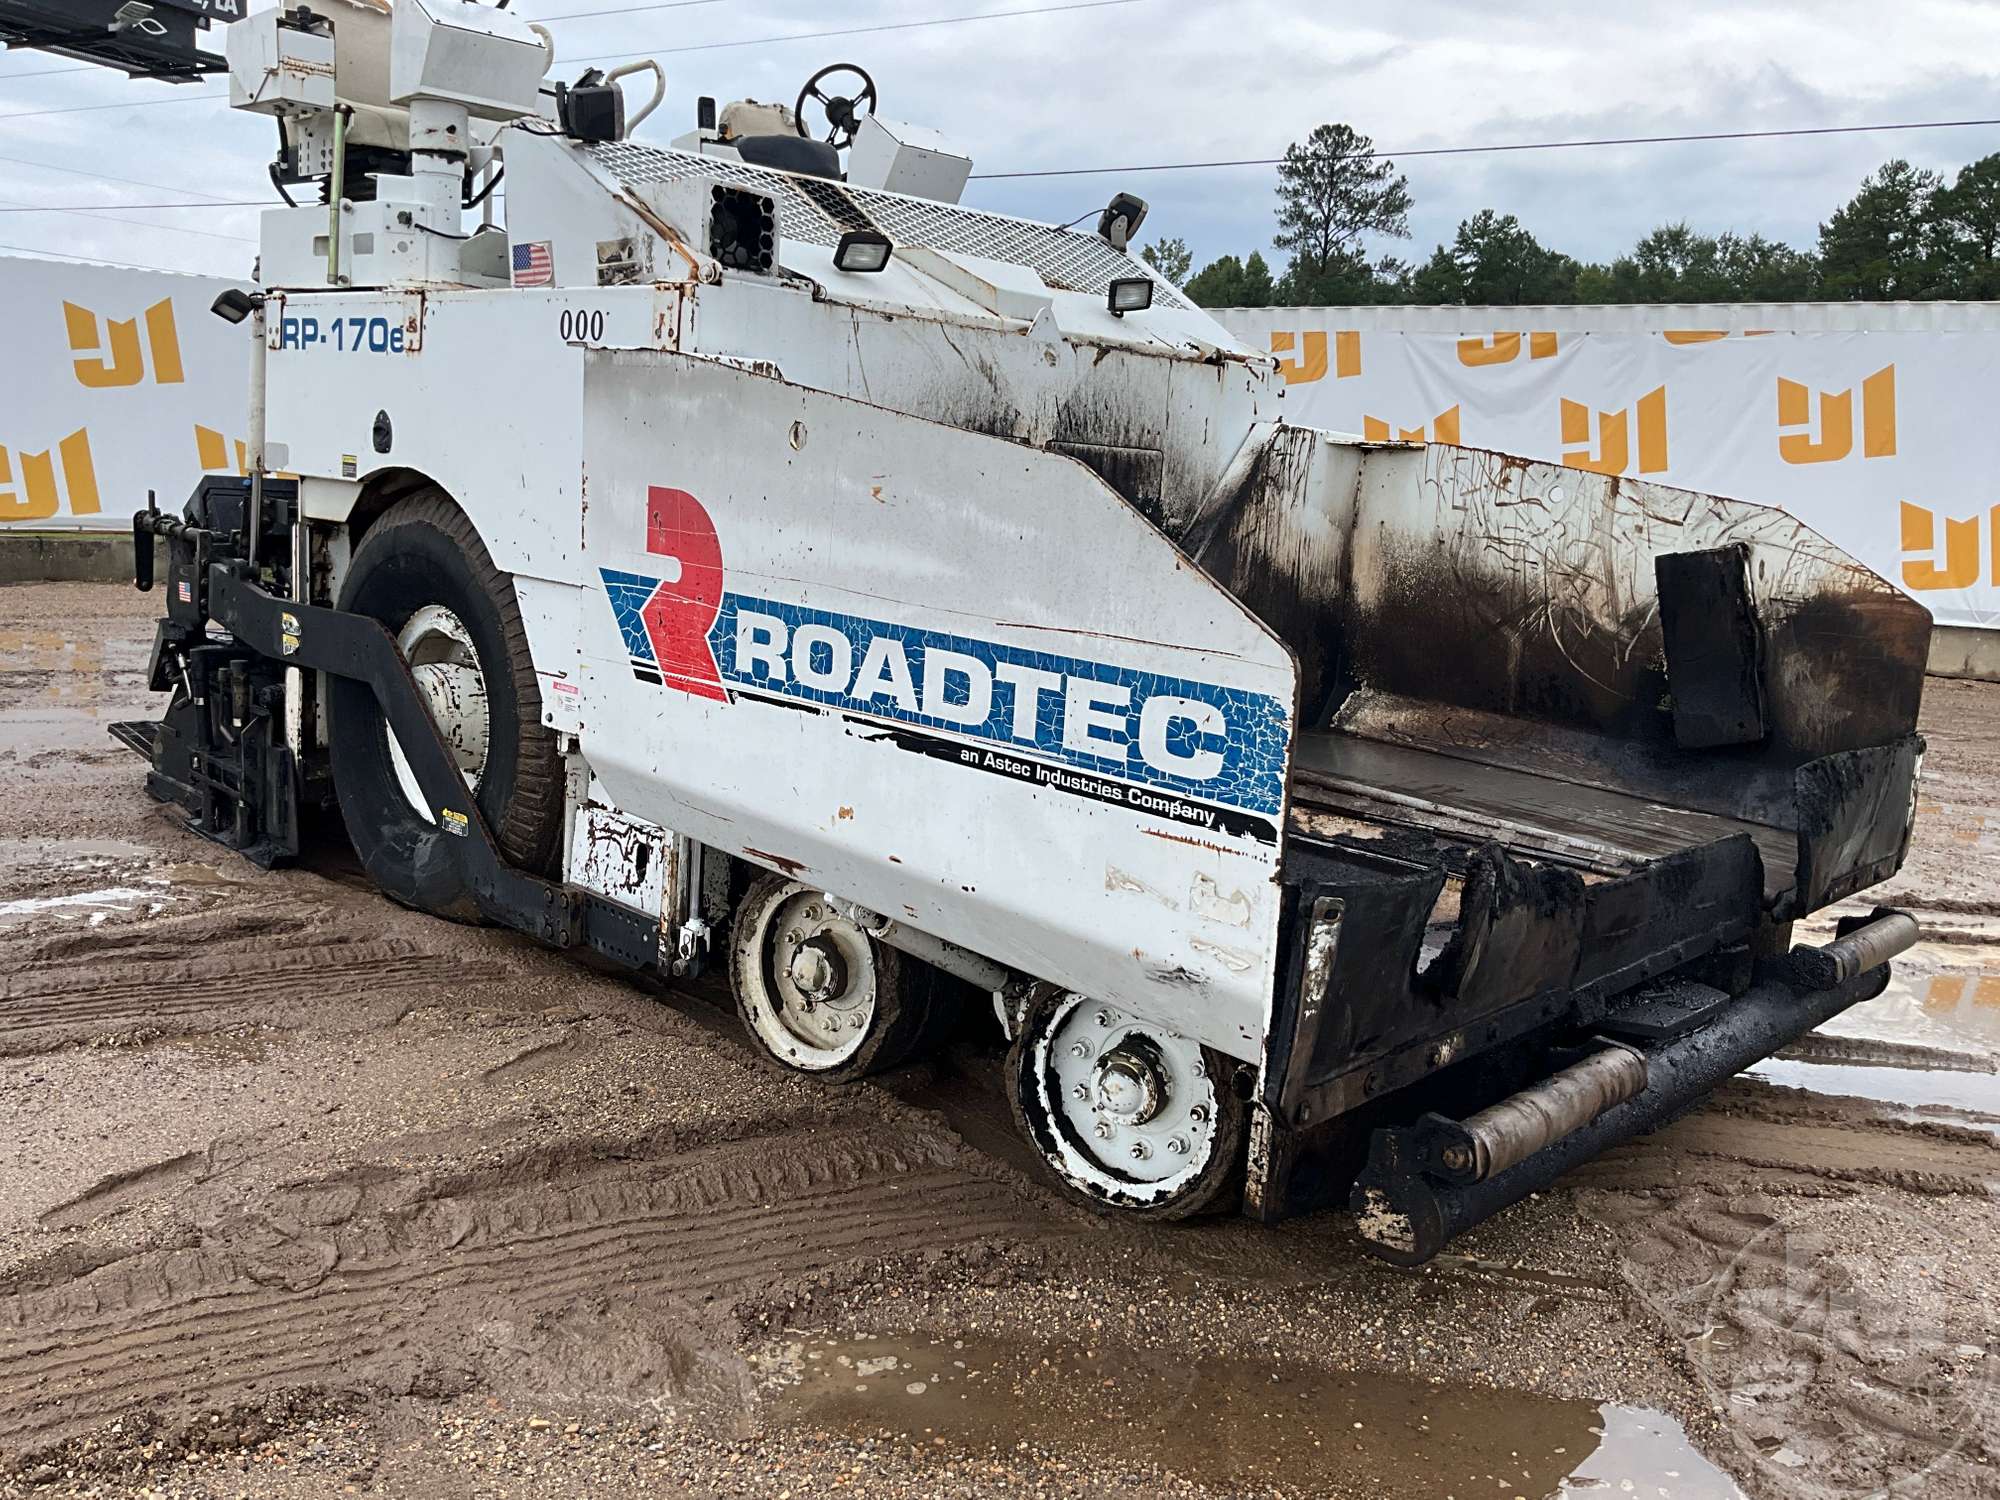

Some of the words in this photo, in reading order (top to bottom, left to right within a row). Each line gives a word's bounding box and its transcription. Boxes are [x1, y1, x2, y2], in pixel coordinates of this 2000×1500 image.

[560, 310, 604, 342] 000
[735, 607, 1227, 781] ROADTEC
[960, 749, 979, 764] an
[983, 752, 1031, 777] Astec
[1036, 764, 1123, 801] Industries
[1127, 788, 1216, 827] Company
